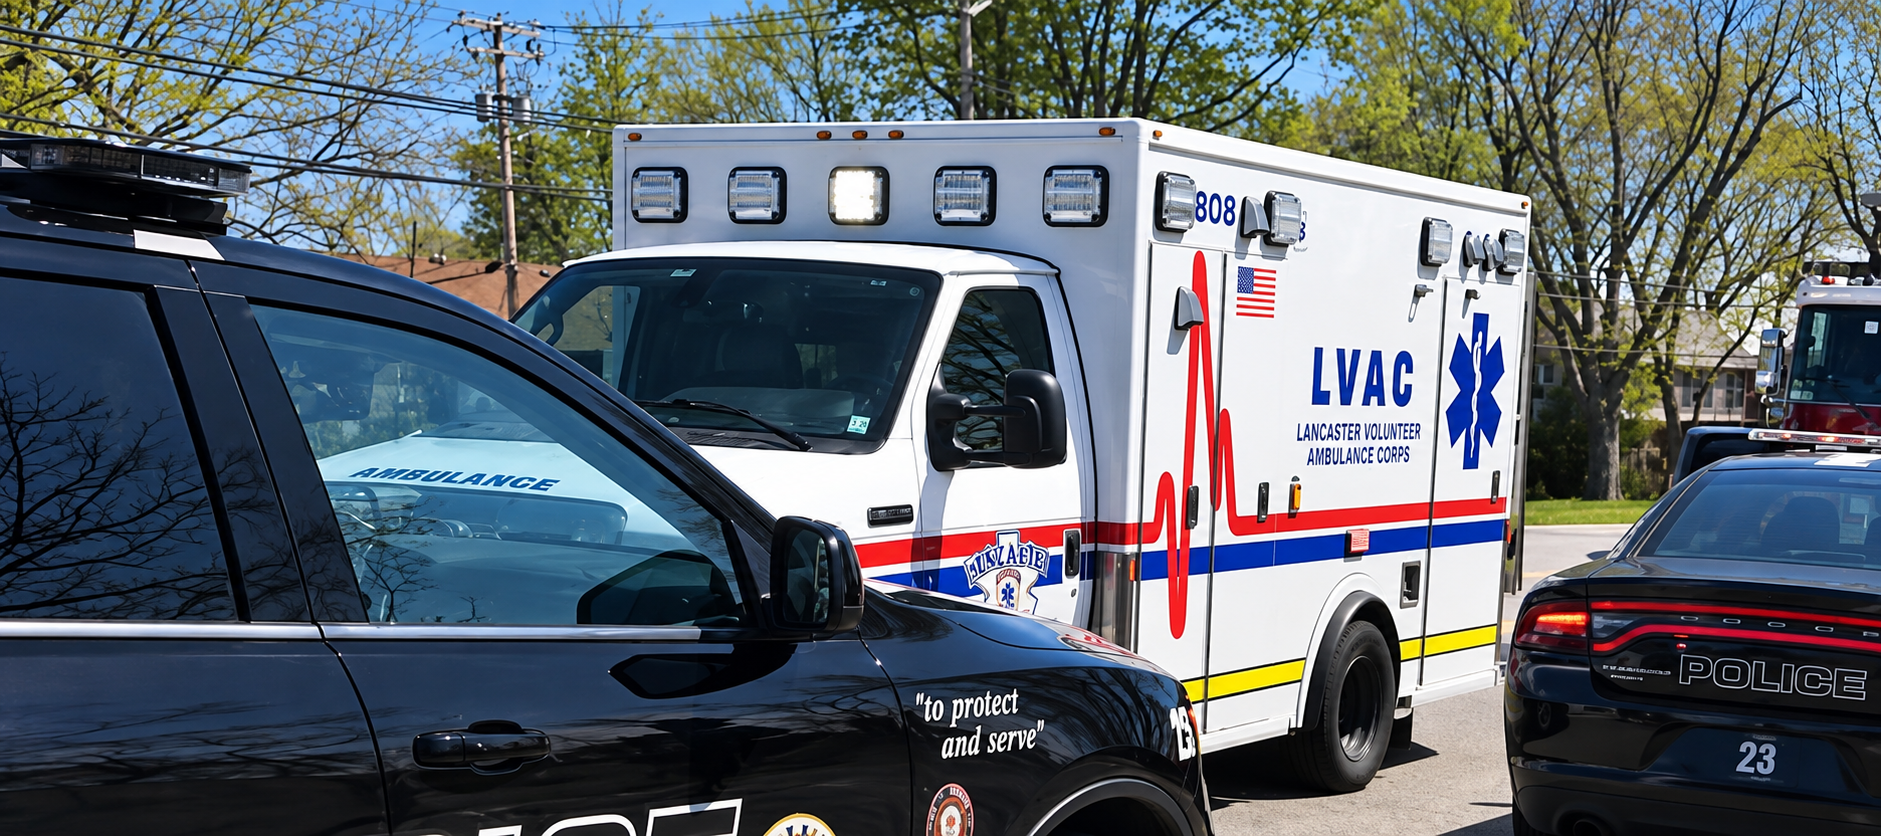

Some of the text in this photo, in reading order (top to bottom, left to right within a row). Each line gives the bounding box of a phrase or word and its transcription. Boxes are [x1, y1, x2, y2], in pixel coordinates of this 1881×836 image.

[1195, 190, 1236, 227] 808
[1311, 346, 1414, 408] LVAC
[1296, 422, 1421, 442] LANCASTER VOLUNTEER
[1306, 445, 1410, 466] AMBULANCE CORPS
[348, 467, 561, 492] AMBULANCE
[1678, 653, 1868, 701] POLICE
[915, 688, 1019, 728] "to protect
[941, 719, 1045, 760] and serve"
[1736, 740, 1777, 776] 23
